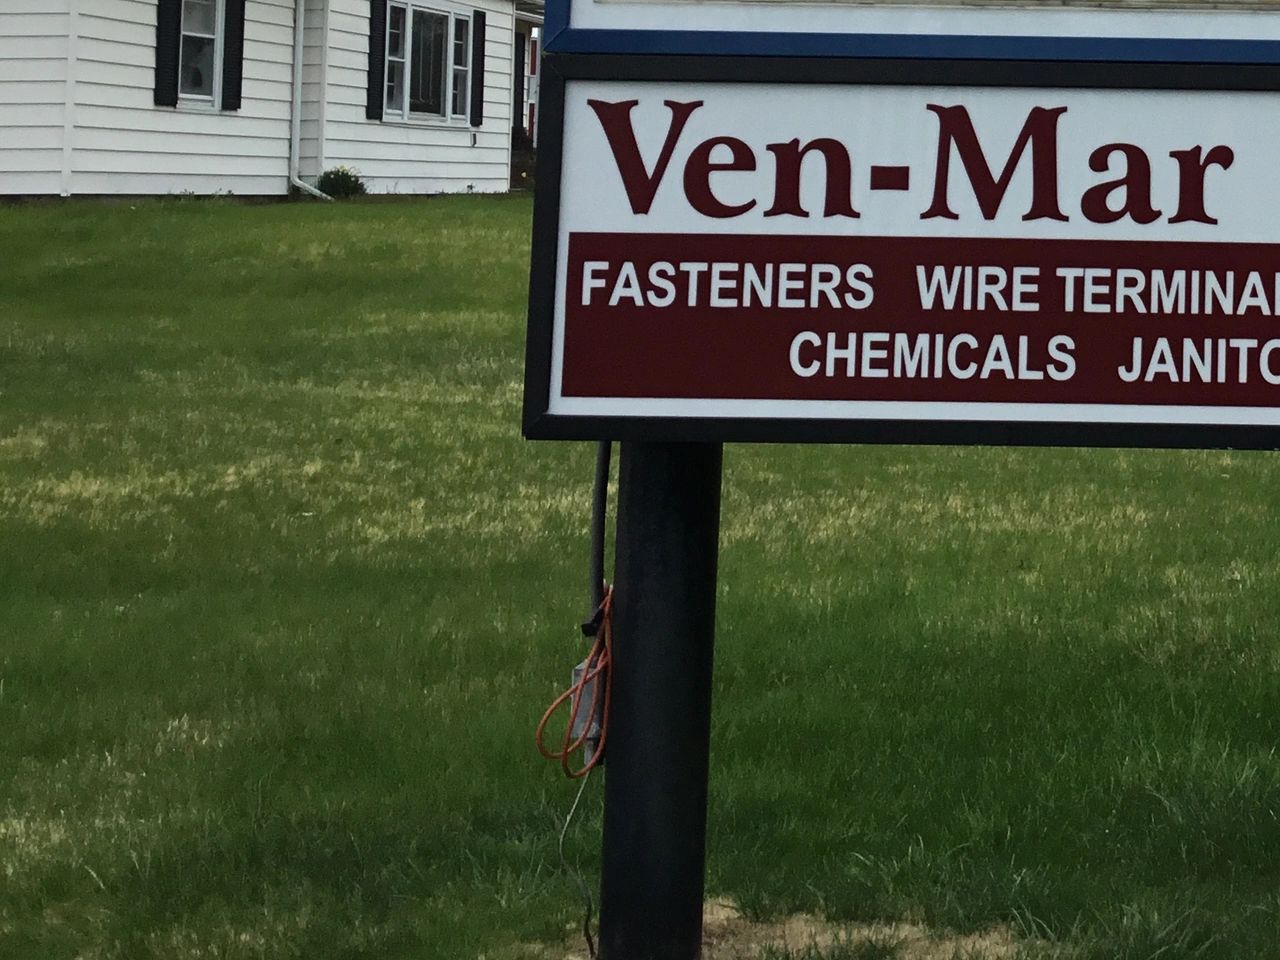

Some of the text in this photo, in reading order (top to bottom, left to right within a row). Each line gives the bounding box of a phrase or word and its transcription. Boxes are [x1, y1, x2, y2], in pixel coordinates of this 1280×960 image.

[587, 98, 1235, 226] Ven-Mar
[581, 261, 875, 310] FASTENERS
[916, 265, 1041, 312] WIRE
[789, 331, 1077, 382] CHEMICALS
